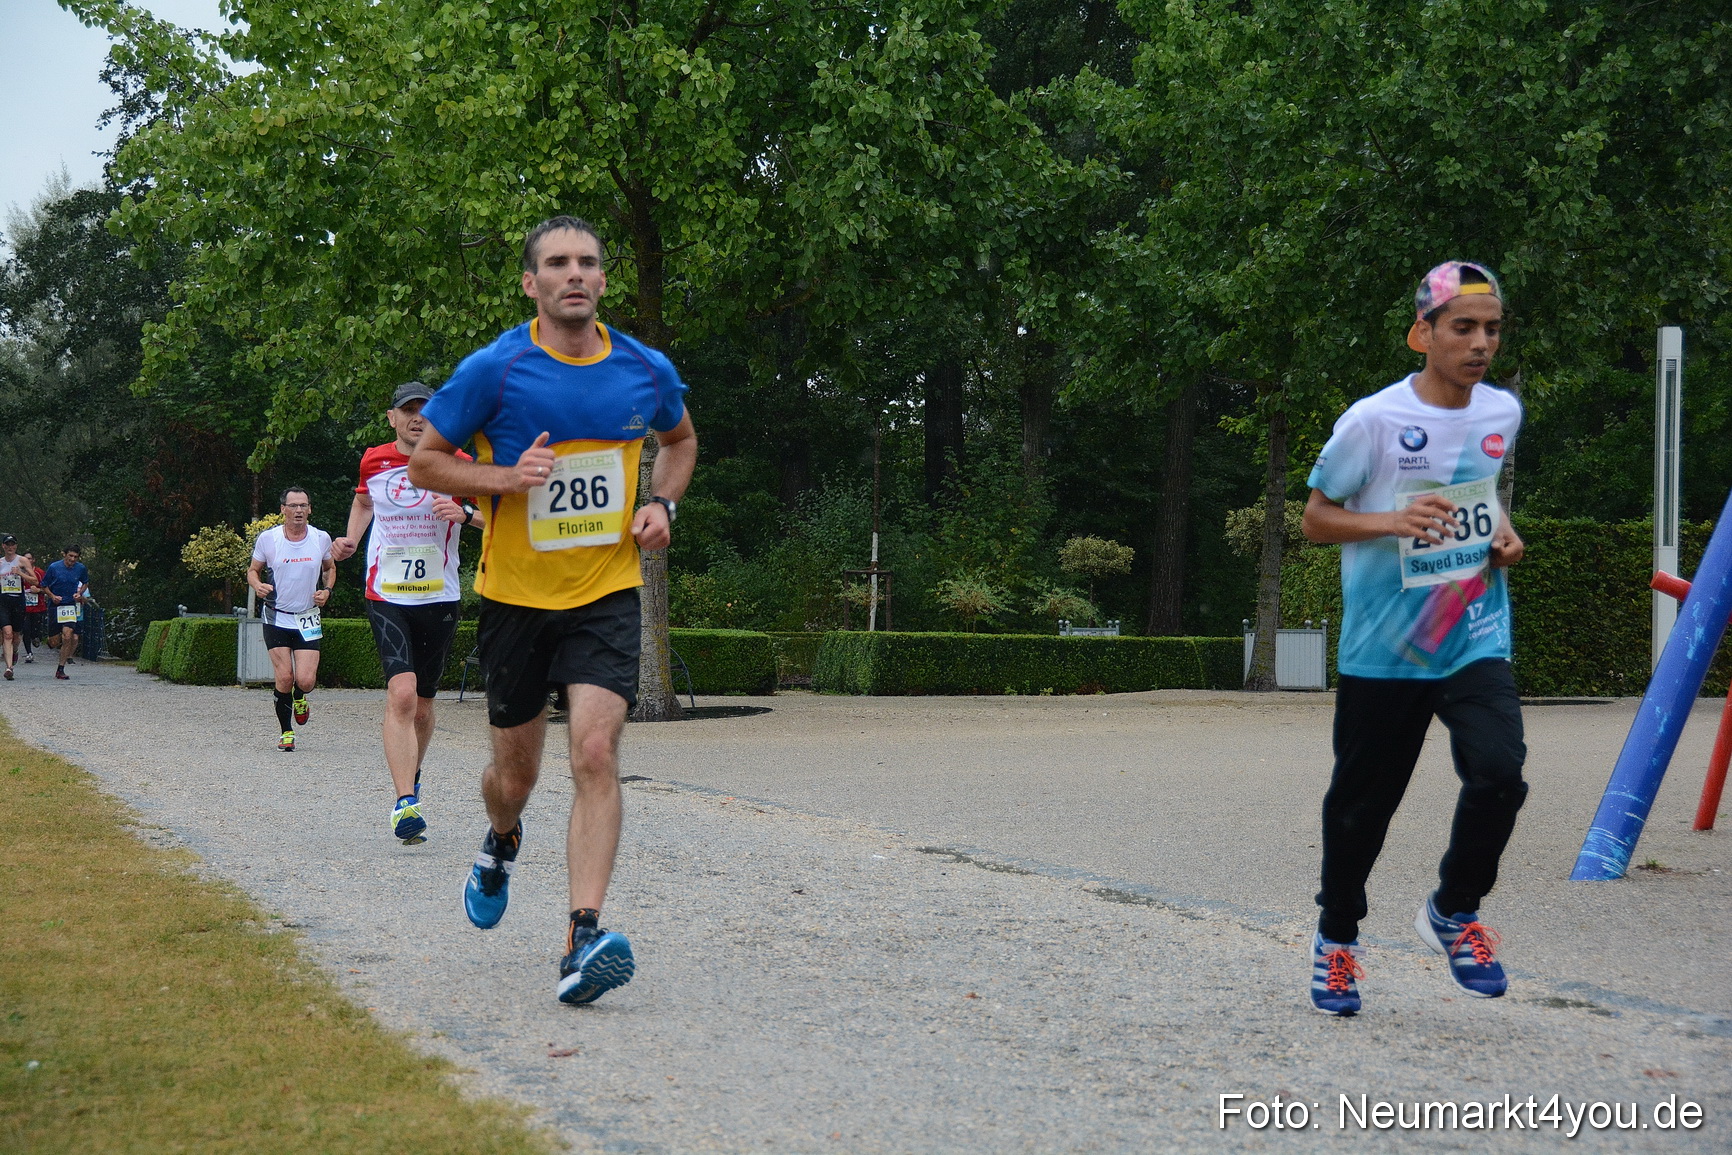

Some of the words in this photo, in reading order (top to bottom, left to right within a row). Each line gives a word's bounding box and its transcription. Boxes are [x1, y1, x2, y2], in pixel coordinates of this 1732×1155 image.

[569, 454, 615, 470] BOCK
[1398, 456, 1430, 465] PARTL
[549, 475, 610, 513] 286
[558, 520, 604, 535] Florian
[401, 559, 426, 580] 78
[1411, 555, 1452, 574] Sayed
[397, 584, 430, 592] Michael
[61, 609, 75, 617] 615
[1466, 602, 1483, 620] 17
